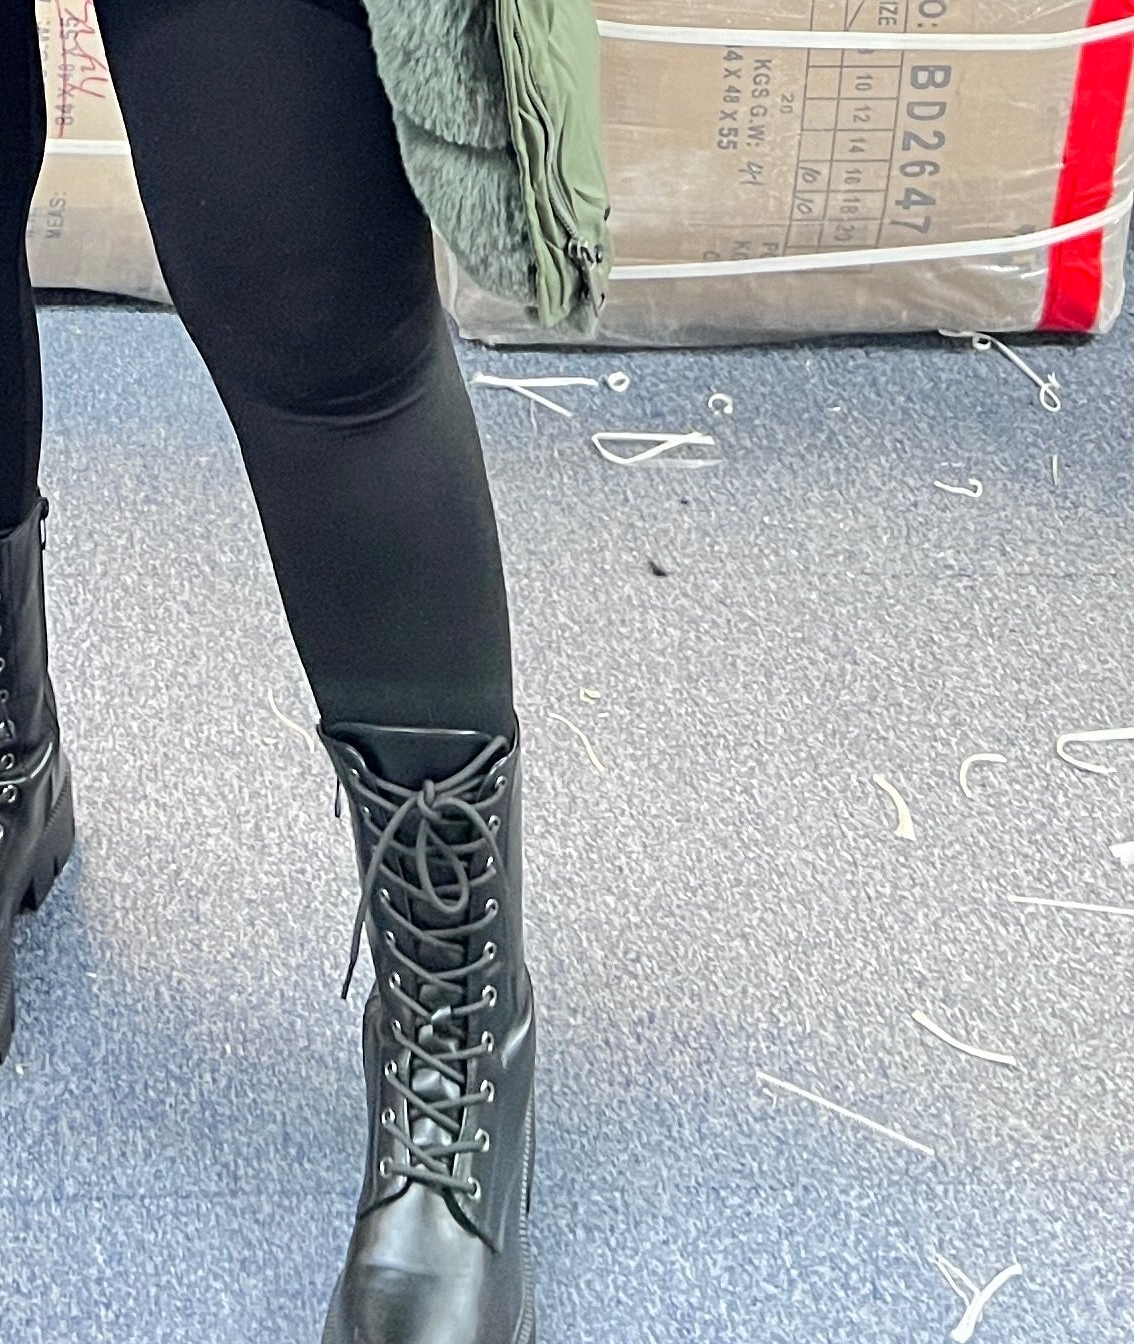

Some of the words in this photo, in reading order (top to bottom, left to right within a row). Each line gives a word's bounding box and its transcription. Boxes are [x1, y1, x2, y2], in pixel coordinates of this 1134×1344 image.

[722, 45, 744, 62] 4
[723, 67, 741, 80] X
[751, 58, 772, 100] KGS
[855, 73, 873, 92] 10
[722, 84, 742, 105] 48
[779, 93, 795, 114] 20
[720, 109, 738, 123] X
[853, 105, 872, 124] 12
[746, 104, 770, 148] G.W:
[717, 126, 739, 151] 55
[849, 136, 866, 154] 14
[889, 65, 952, 234] BD2647
[844, 167, 862, 186] 16
[839, 195, 862, 214] 18
[46, 192, 67, 239] MEAS:
